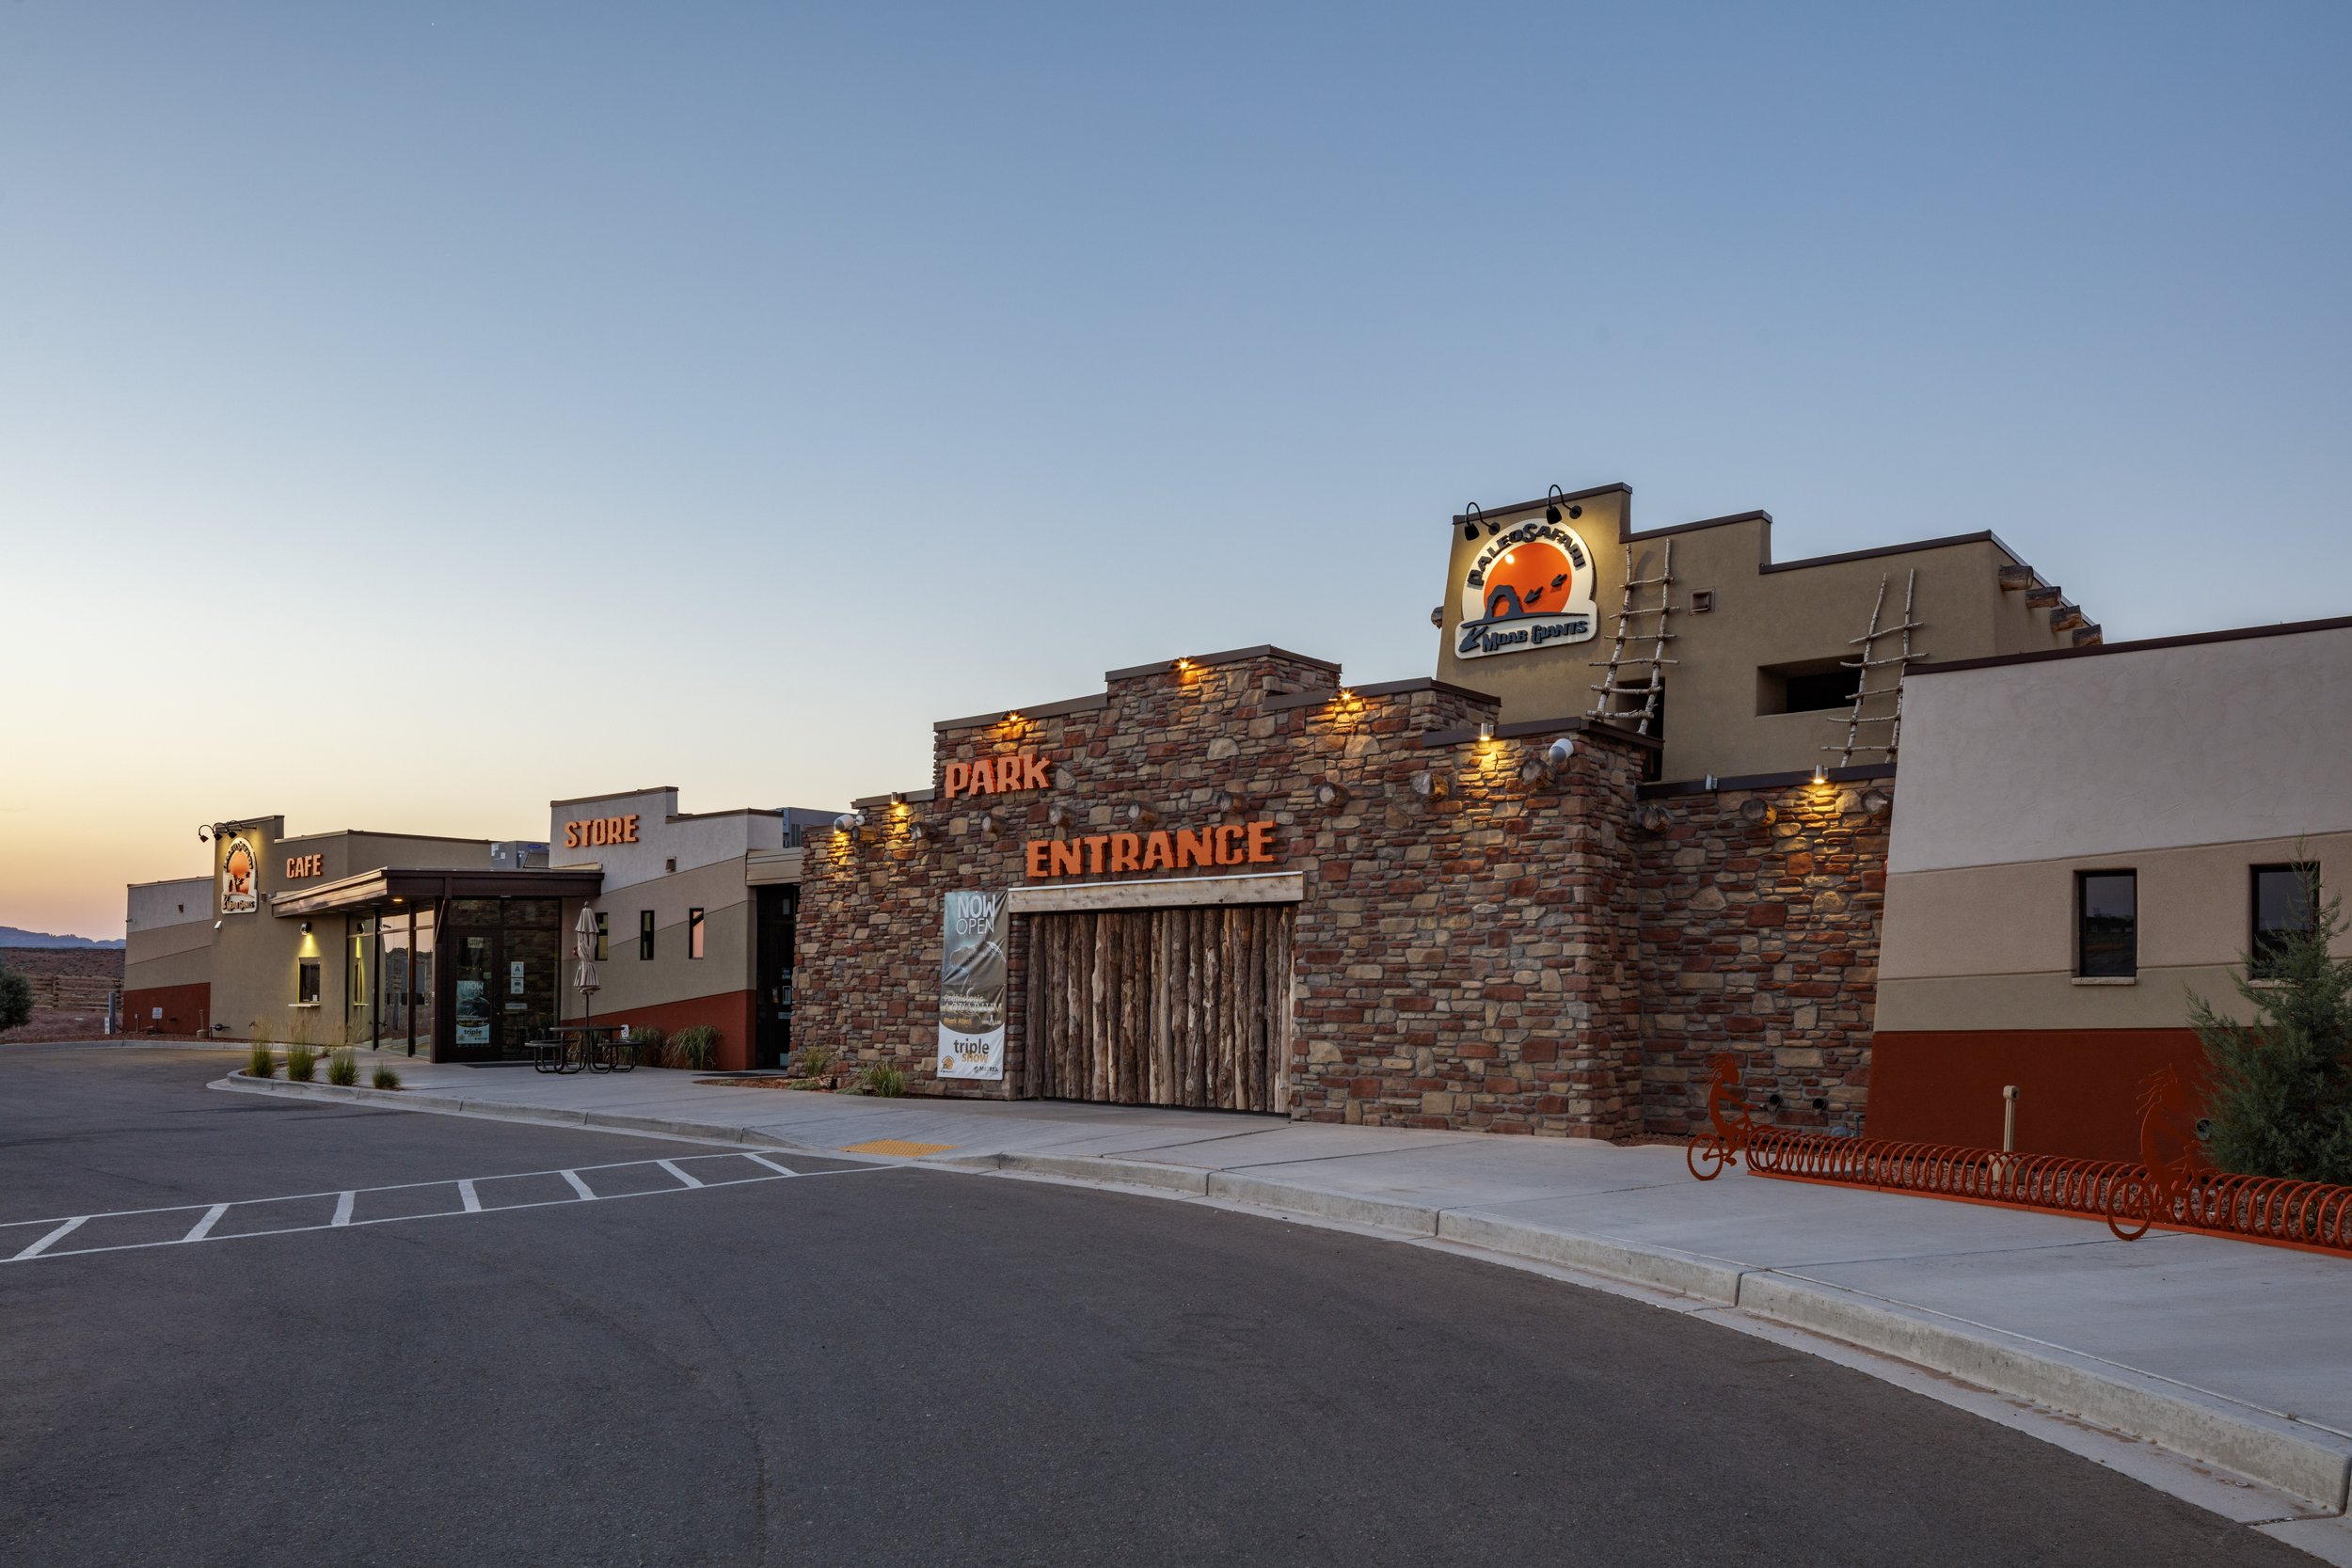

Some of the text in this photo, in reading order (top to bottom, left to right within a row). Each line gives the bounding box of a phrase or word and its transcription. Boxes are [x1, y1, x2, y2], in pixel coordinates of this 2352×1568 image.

[1482, 621, 1588, 652] MOAB GIANTS
[945, 753, 1054, 798] PARK
[564, 815, 640, 847] STORE
[1026, 820, 1277, 878] ENTRANCE
[286, 853, 323, 879] CAFE
[957, 895, 996, 918] NOW
[956, 917, 994, 935] OPEN
[463, 981, 484, 990] NOW
[953, 1037, 990, 1055] triple
